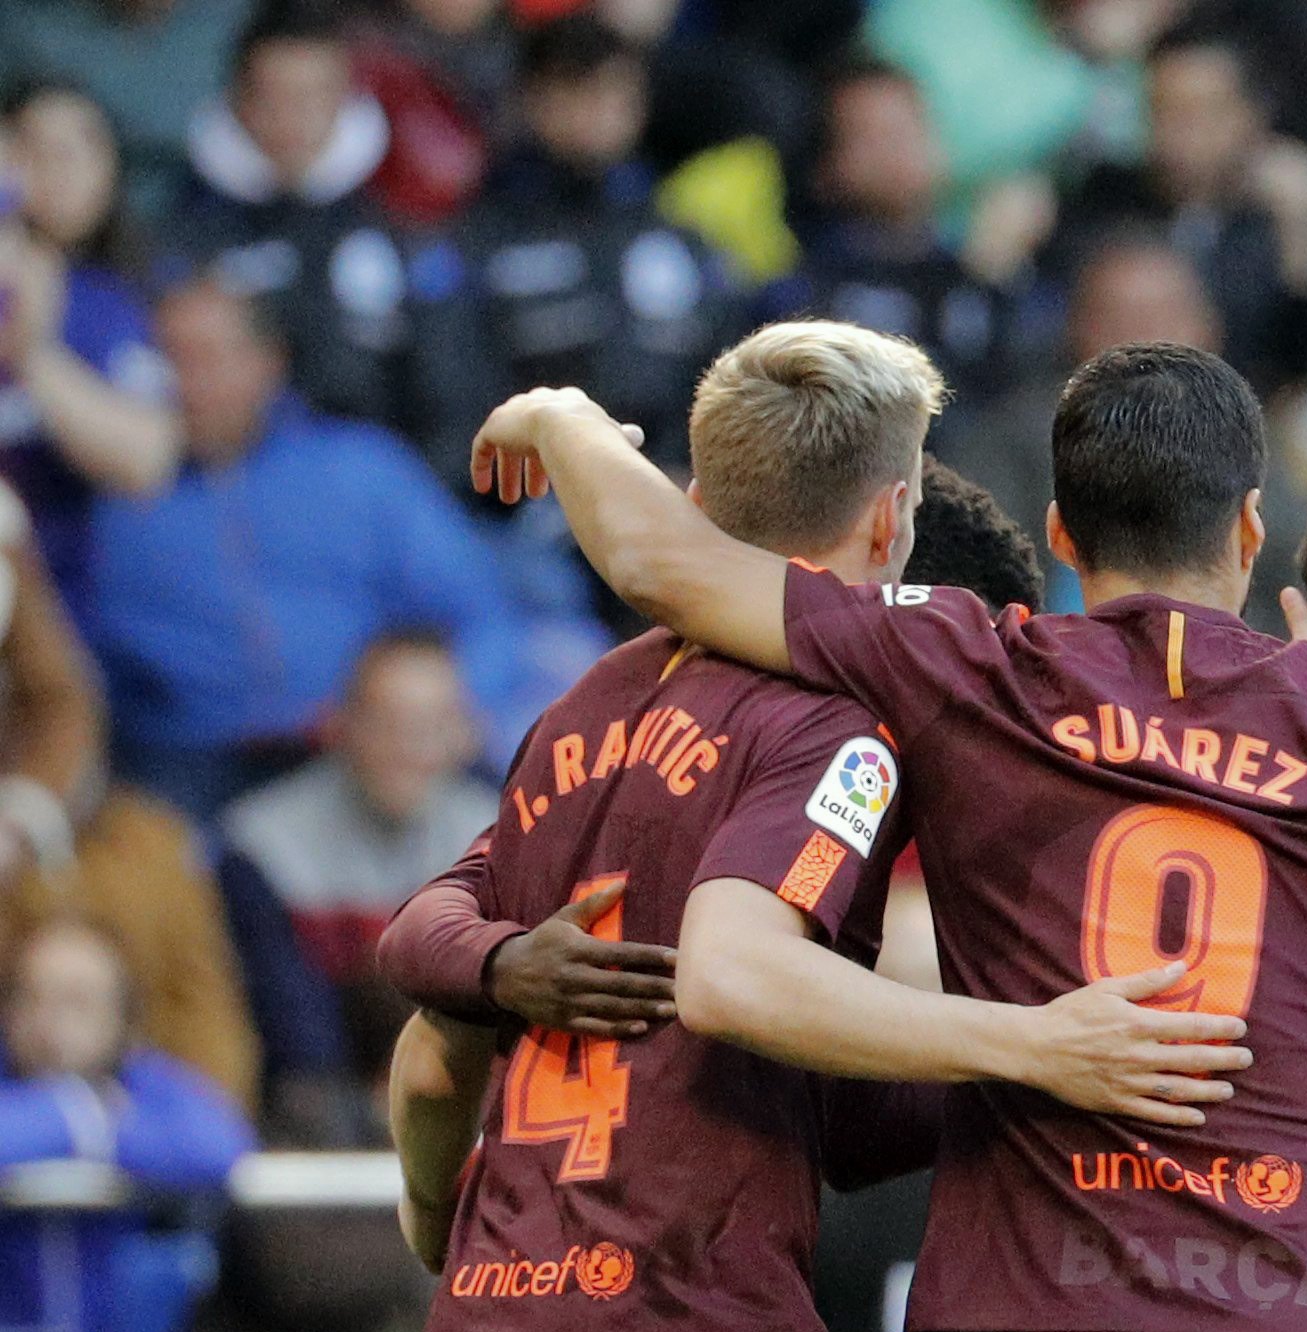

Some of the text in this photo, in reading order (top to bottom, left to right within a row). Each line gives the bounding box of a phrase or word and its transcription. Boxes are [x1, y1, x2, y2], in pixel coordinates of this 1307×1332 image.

[818, 792, 874, 844] LaLiga
[1079, 803, 1269, 1082] 9
[1071, 1142, 1230, 1204] unicef
[450, 1244, 579, 1298] unicef
